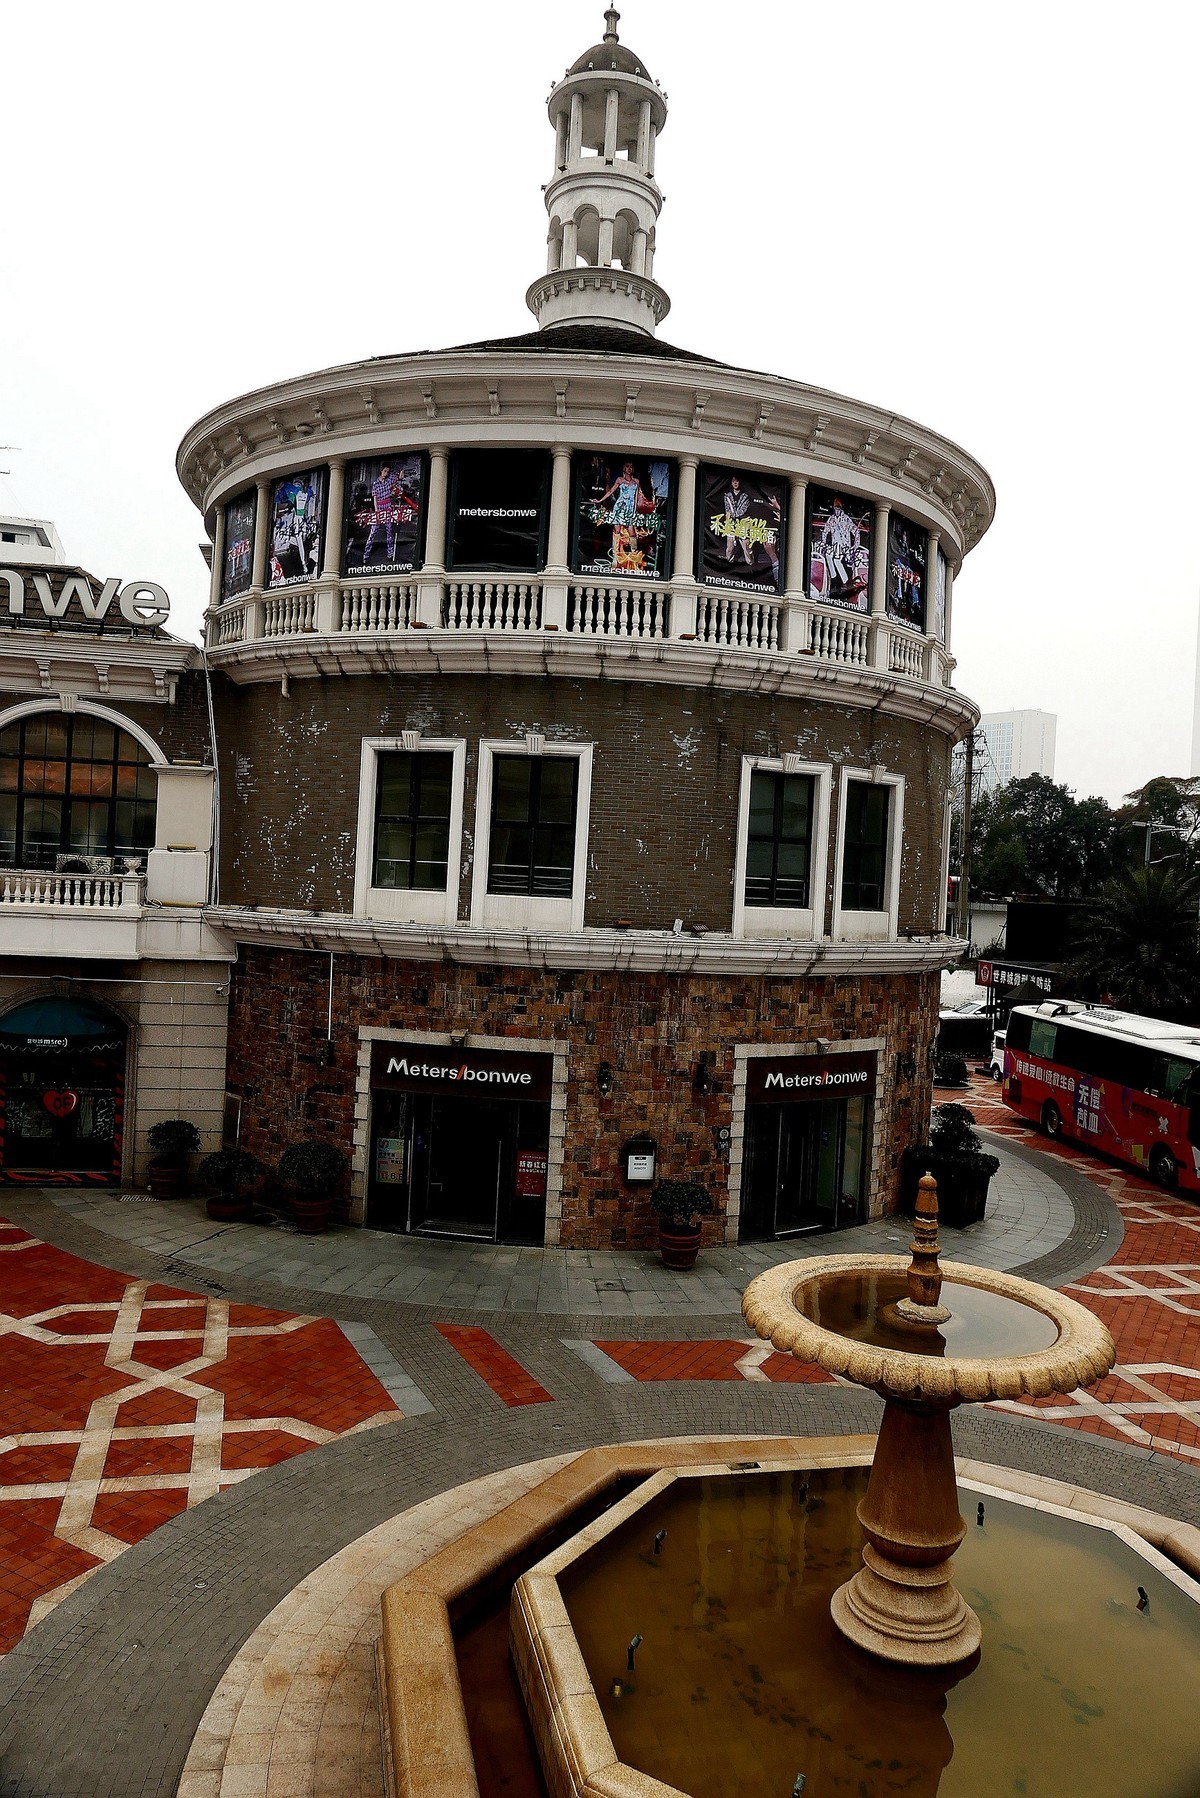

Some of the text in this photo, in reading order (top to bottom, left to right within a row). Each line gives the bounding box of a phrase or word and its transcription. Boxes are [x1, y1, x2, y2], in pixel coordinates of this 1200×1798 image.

[459, 507, 537, 517] metersbonwe
[348, 562, 413, 574] metersbonwe
[581, 564, 660, 578] metersbonwe
[705, 575, 776, 593] metersbonwe
[386, 1057, 532, 1084] Meters/bonwe
[764, 1071, 868, 1089] Meters/bonwe
[1078, 1083, 1100, 1110] 无偿
[1077, 1107, 1099, 1134] 献血
